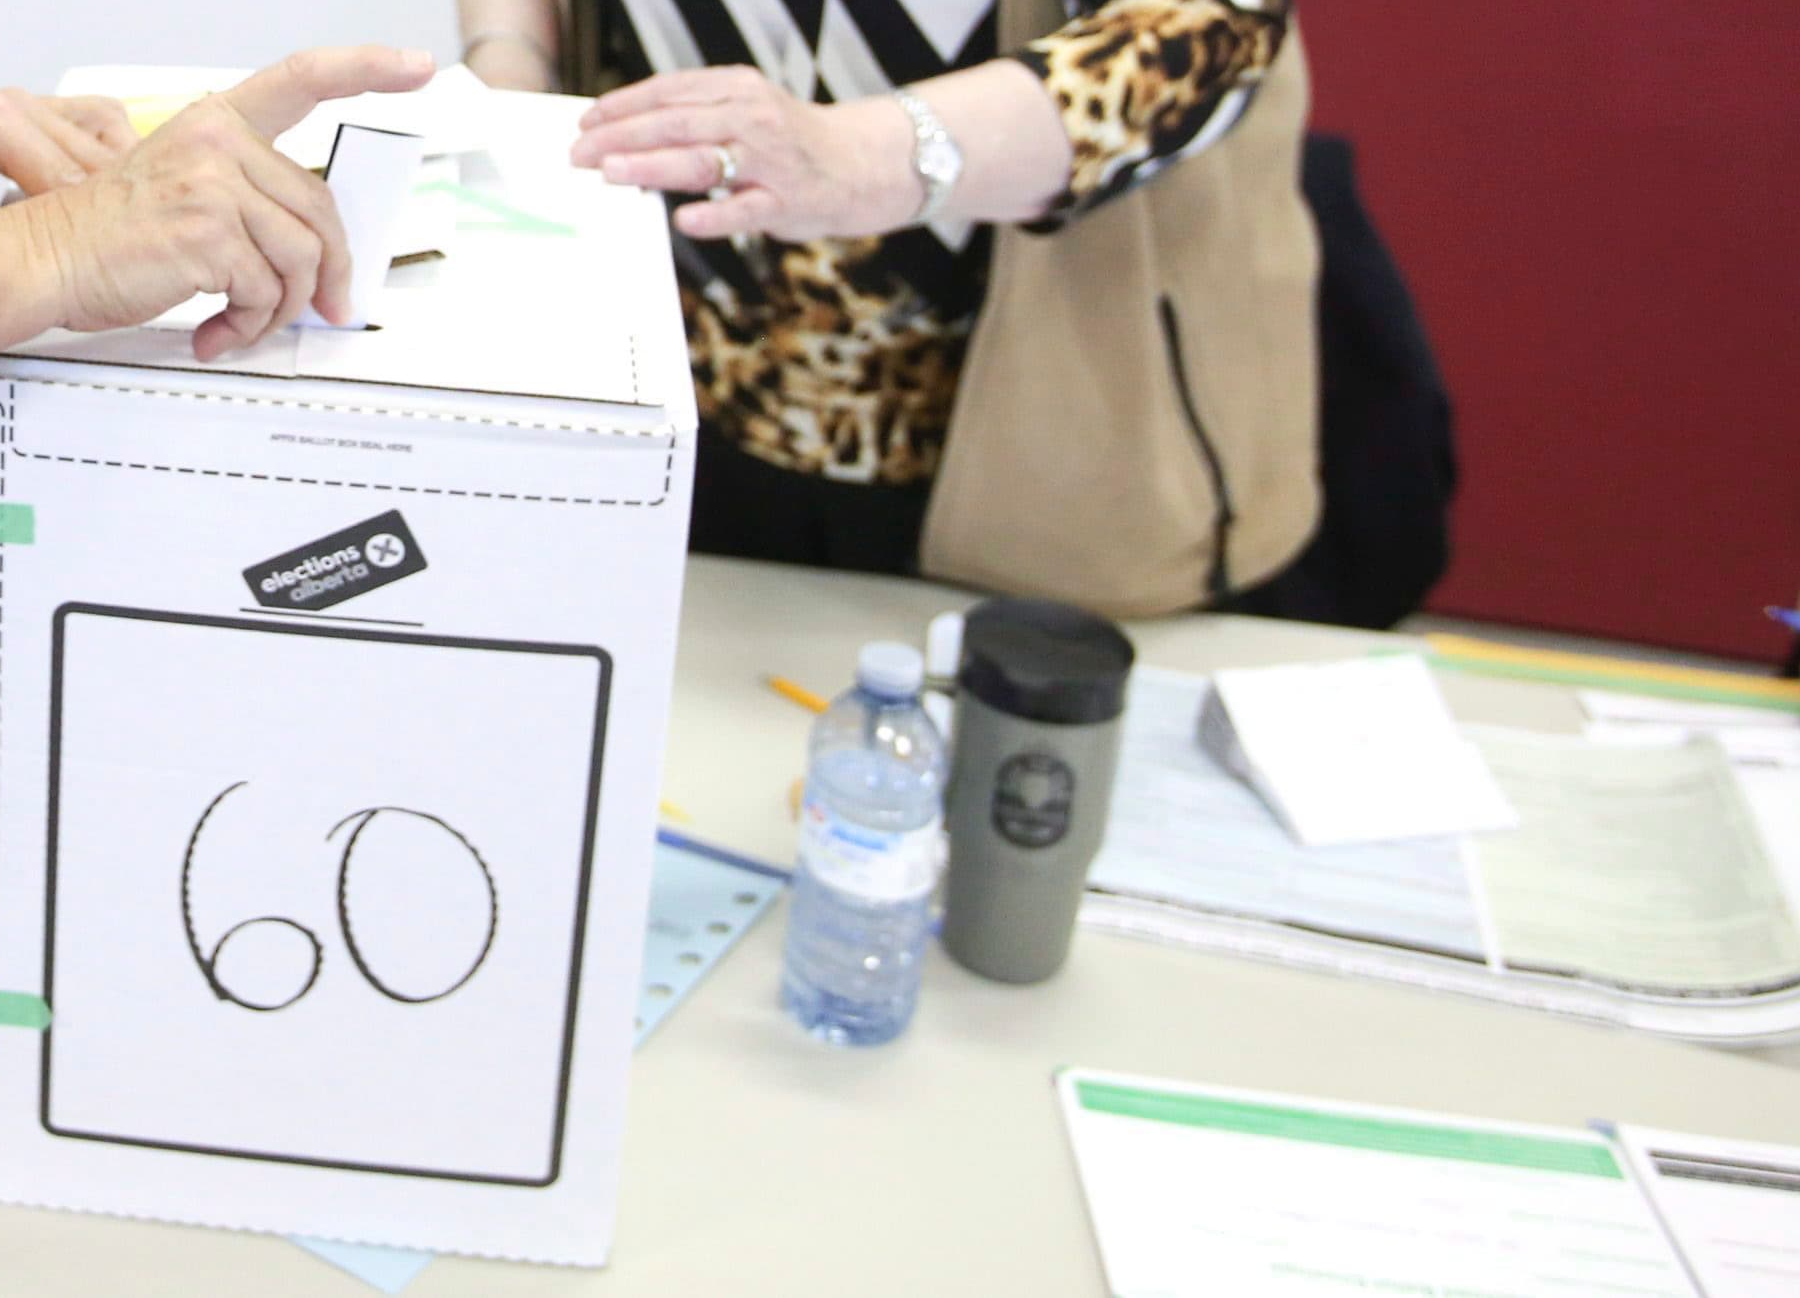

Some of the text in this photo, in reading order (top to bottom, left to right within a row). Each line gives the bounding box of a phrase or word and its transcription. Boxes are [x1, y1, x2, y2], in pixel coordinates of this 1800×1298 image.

[299, 435, 336, 445] BALLOT
[337, 438, 357, 447] BOX
[360, 440, 384, 450] SEAL
[386, 443, 413, 453] HERE
[260, 545, 361, 593] elections
[290, 562, 370, 602] alberta
[181, 780, 498, 1012] 60
